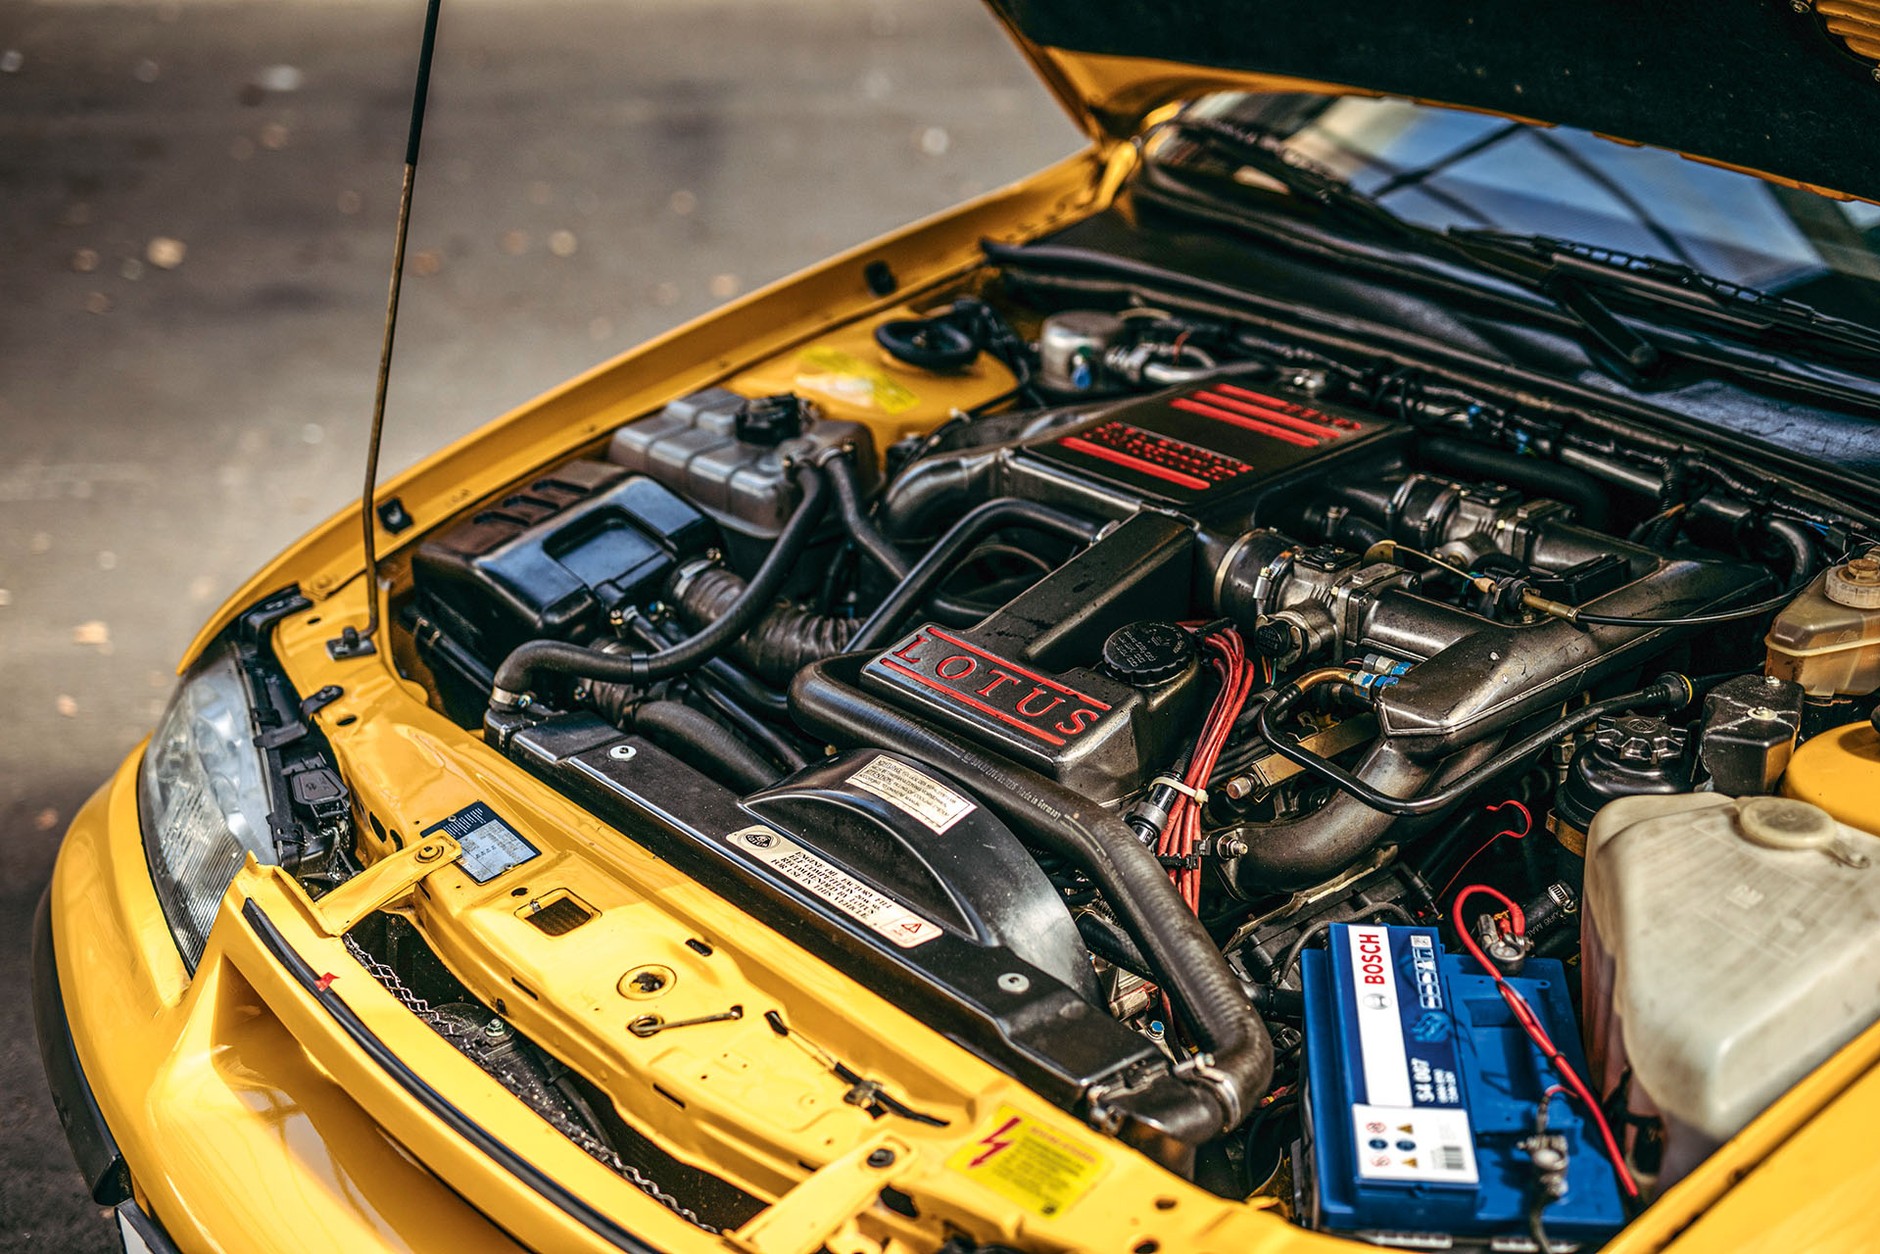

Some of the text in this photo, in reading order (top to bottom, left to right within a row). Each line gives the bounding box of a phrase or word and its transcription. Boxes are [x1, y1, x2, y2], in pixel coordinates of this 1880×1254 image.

[891, 634, 1100, 735] LOTUS
[1037, 799, 1061, 820] Germany
[770, 859, 787, 868] FOR
[786, 868, 802, 877] USE
[813, 885, 833, 896] THIS
[781, 857, 837, 891] RECOMMENDED
[849, 898, 875, 914] LOTUS
[795, 851, 824, 868] ENGINE
[841, 878, 873, 897] FACTORY
[874, 898, 892, 907] FILL
[804, 863, 853, 893] COMPETITION
[1358, 933, 1386, 985] BOSCH
